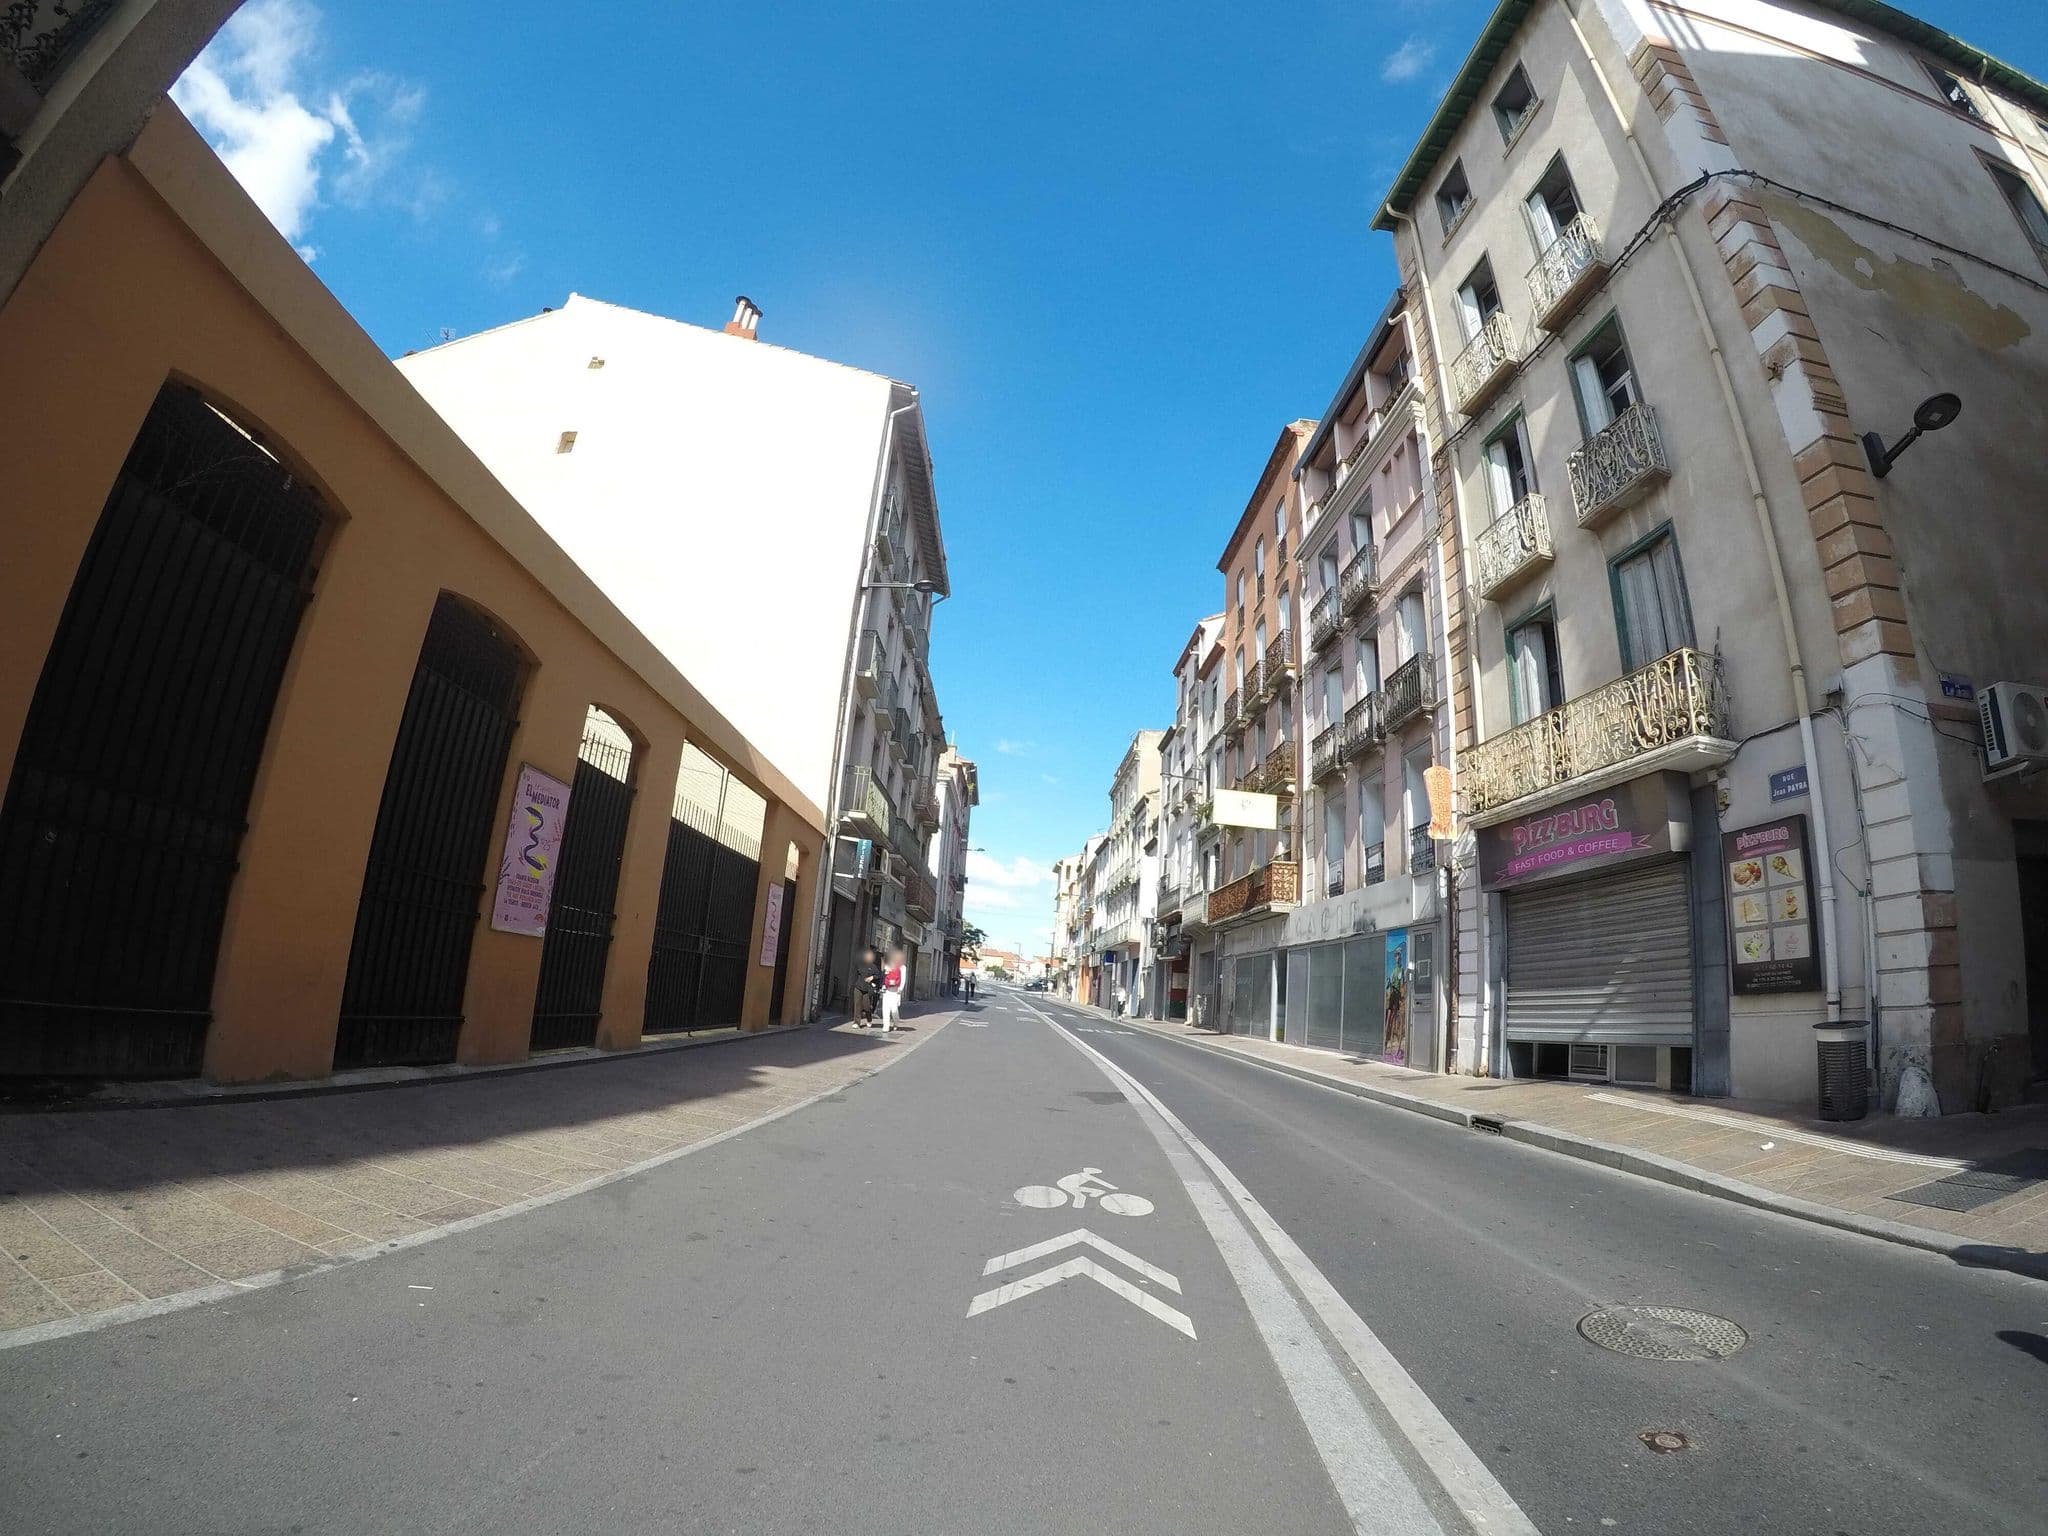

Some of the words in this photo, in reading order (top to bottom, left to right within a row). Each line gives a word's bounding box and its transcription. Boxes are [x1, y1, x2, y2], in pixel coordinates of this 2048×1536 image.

[1782, 772, 1795, 782] RUE
[525, 784, 533, 797] EL
[531, 791, 561, 810] MEDIATOR
[1435, 770, 1446, 821] KEBAB
[1773, 788, 1786, 797] Jean
[1514, 857, 1536, 872] FAST
[1538, 848, 1565, 863] FOOD
[1567, 846, 1575, 856] &
[1577, 838, 1619, 854] COFFEE
